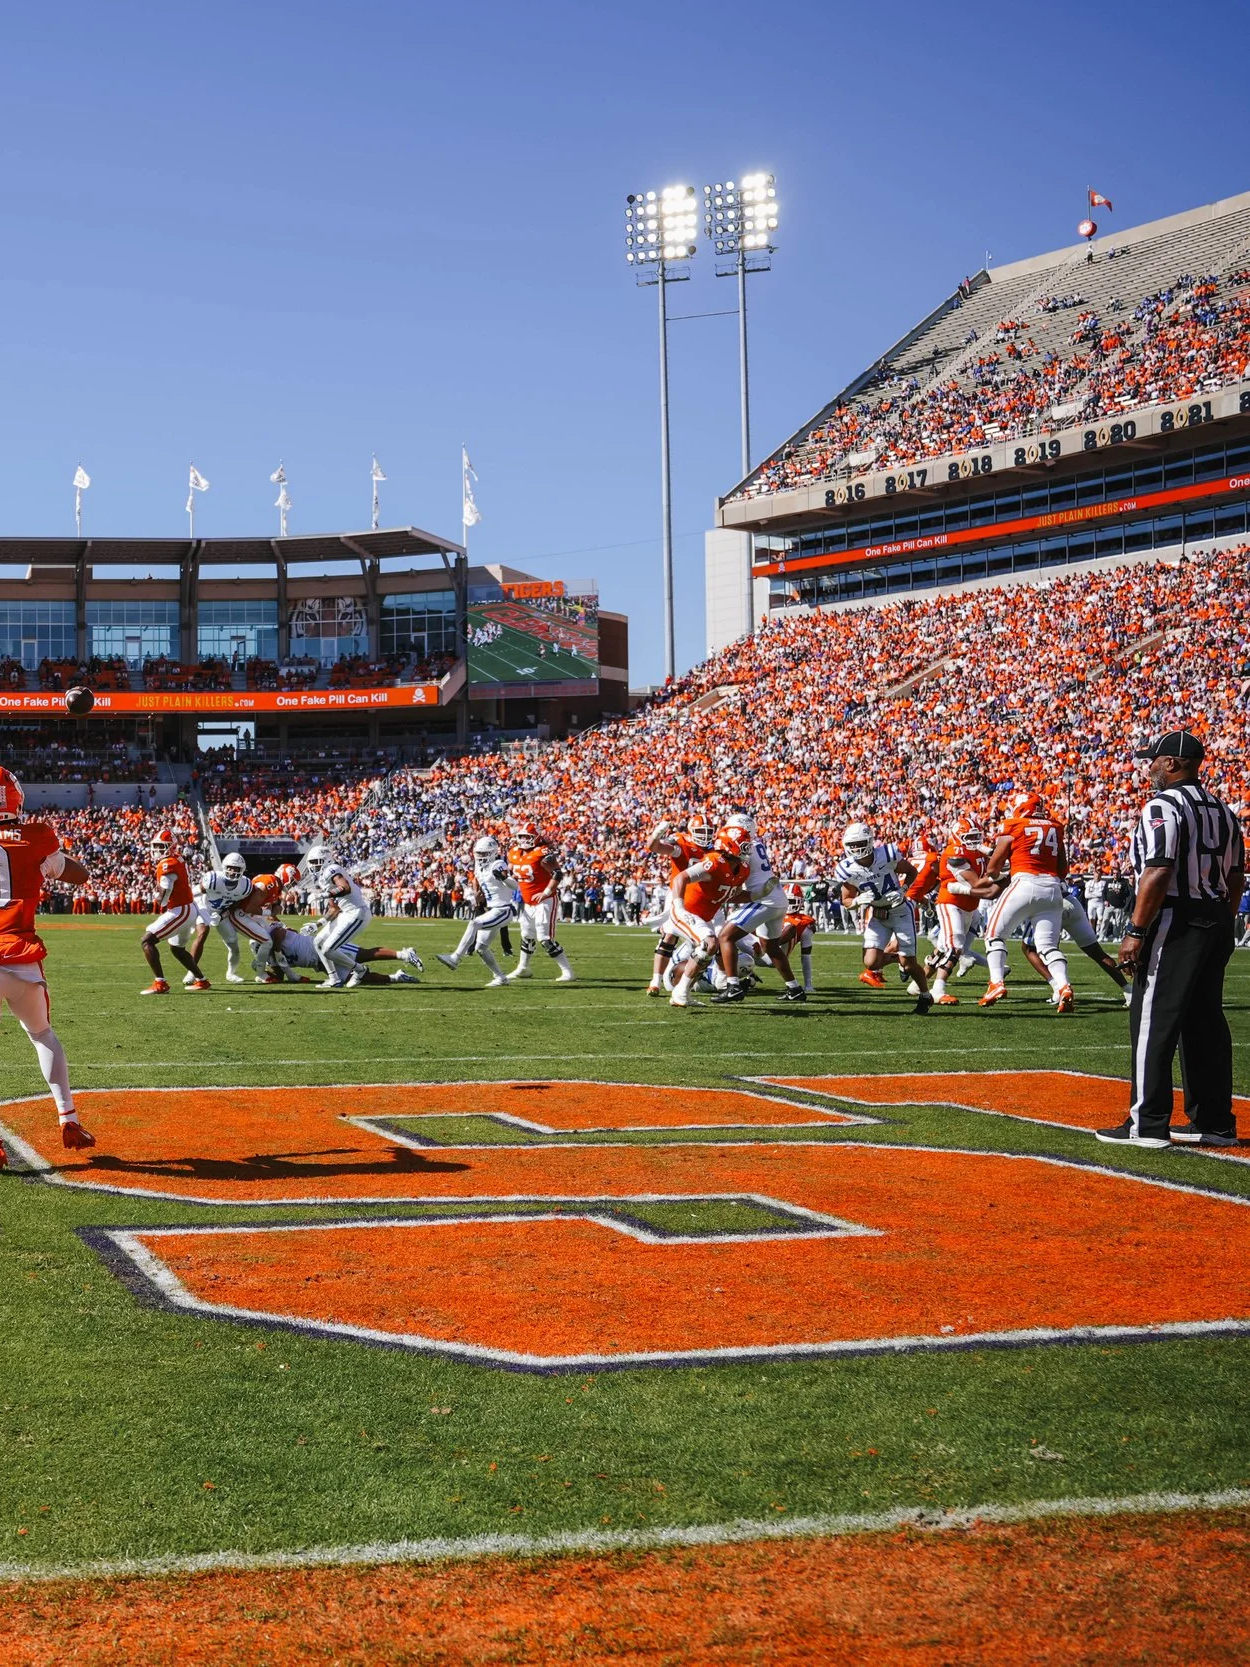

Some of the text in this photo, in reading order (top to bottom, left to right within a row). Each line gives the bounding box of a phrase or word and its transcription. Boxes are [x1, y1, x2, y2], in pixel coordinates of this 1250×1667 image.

[1037, 513, 1058, 528] JUST
[1059, 508, 1083, 525] PLAIN
[865, 534, 948, 557] One Fake Pill Can Kill
[499, 581, 565, 599] TIGERS
[0, 697, 111, 707] One Fake Pil Kill
[136, 696, 161, 707] JUST
[163, 696, 191, 707] PLAIN
[276, 693, 388, 706] One Fake Pill Can Kill
[1196, 805, 1221, 849] U
[953, 846, 964, 855] 71
[1024, 826, 1058, 857] 74
[512, 865, 535, 883] 53
[866, 873, 881, 881] DUKE
